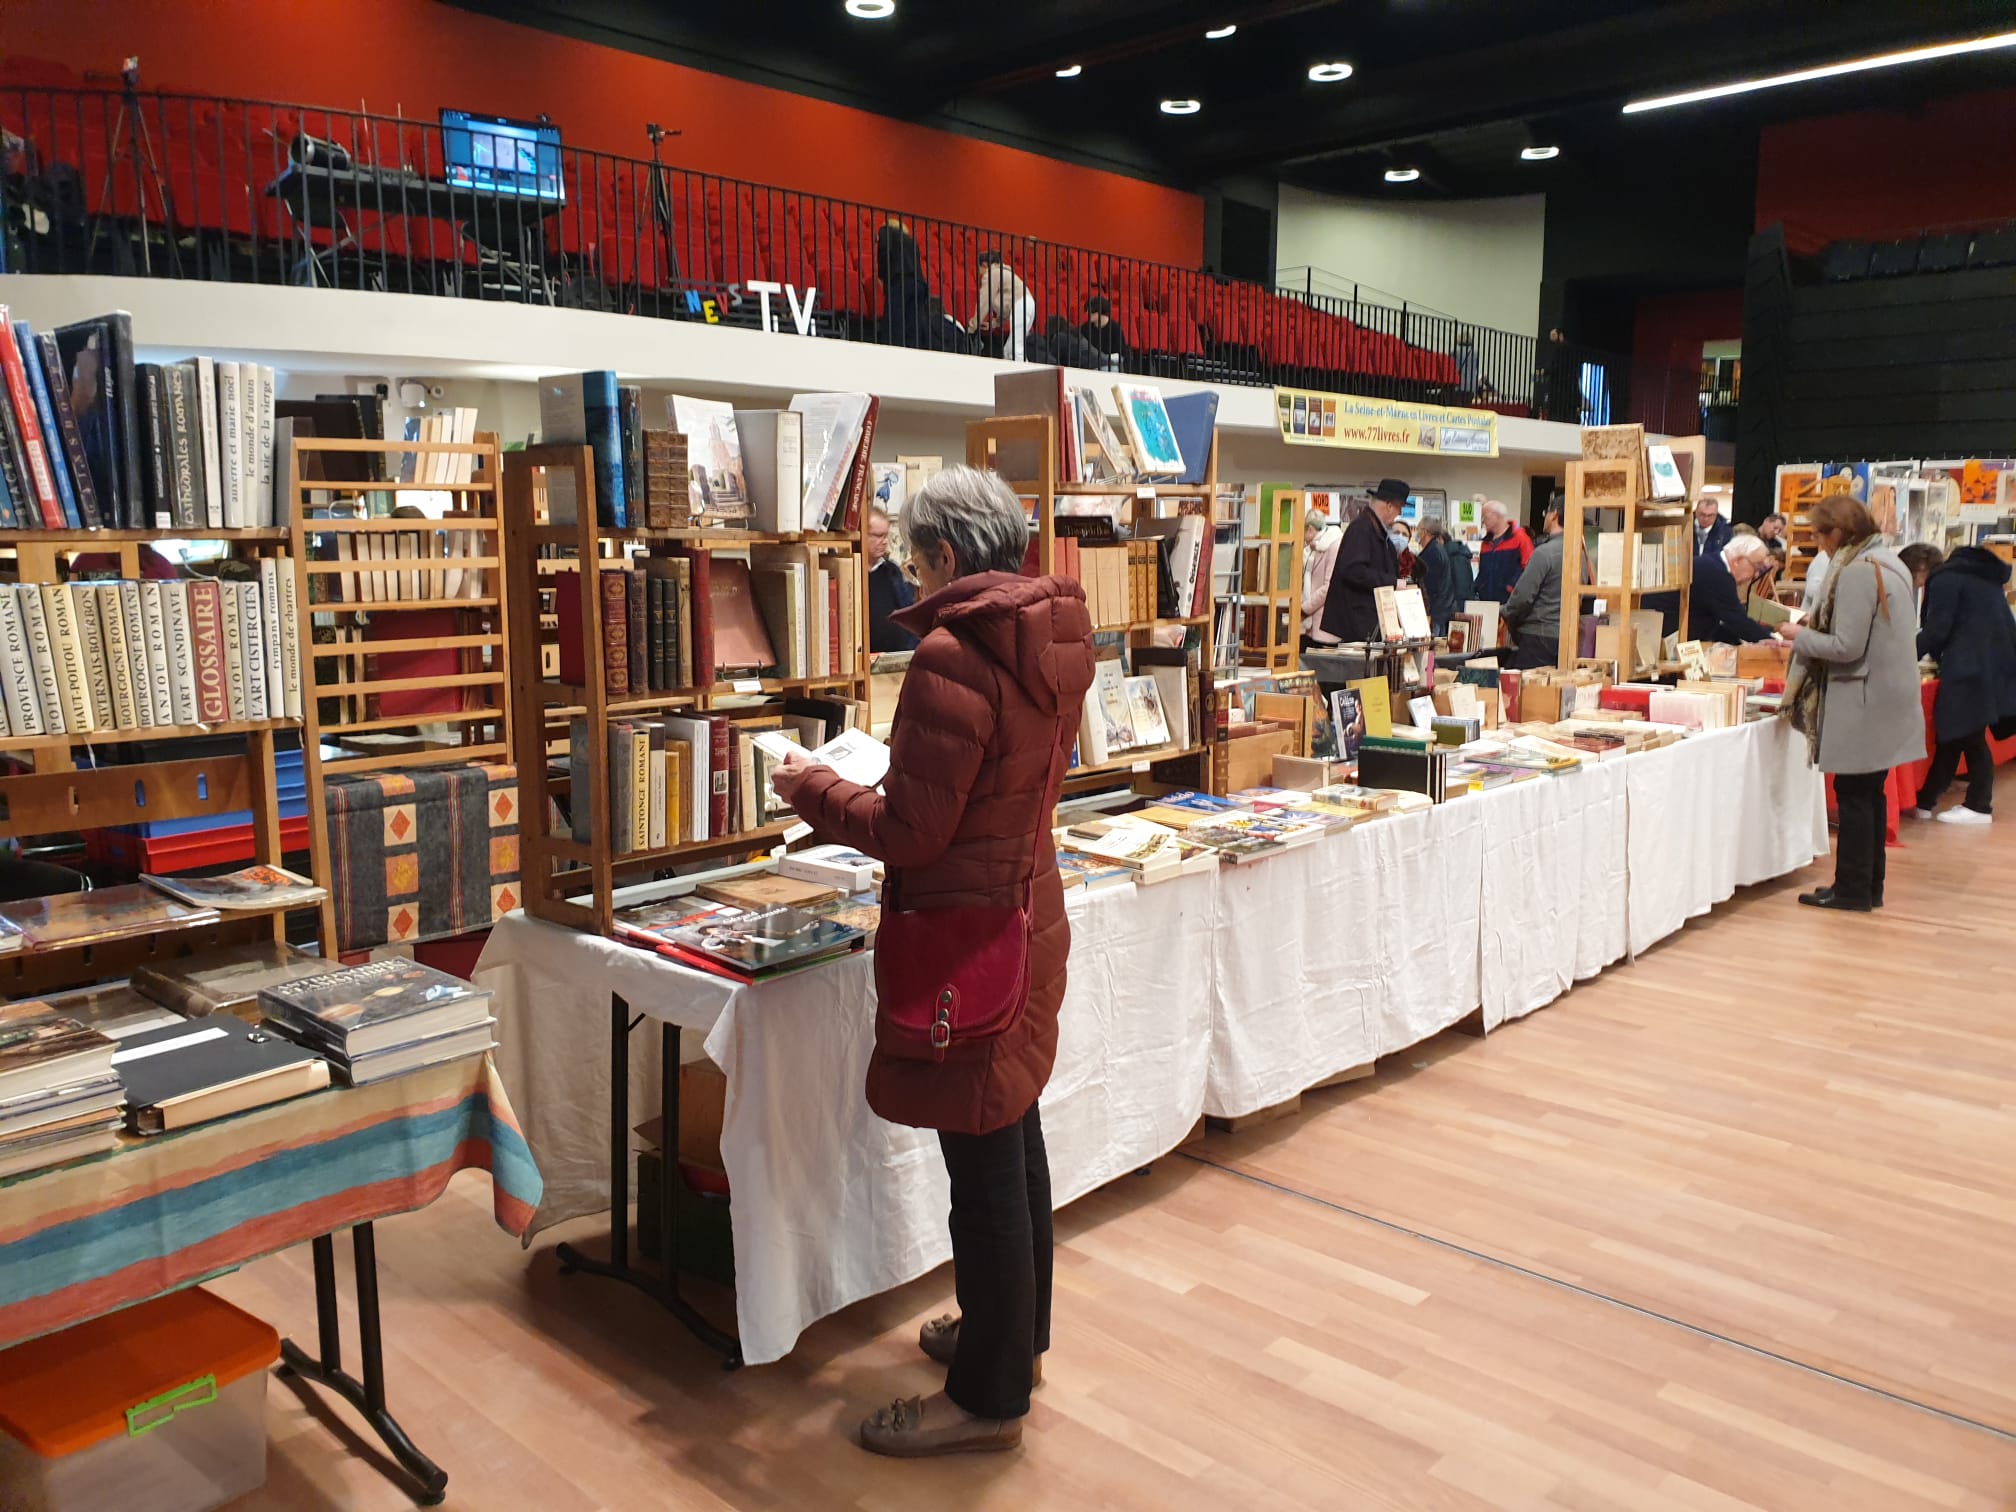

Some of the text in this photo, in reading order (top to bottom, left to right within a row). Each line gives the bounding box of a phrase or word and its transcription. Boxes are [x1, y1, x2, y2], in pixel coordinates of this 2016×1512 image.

[224, 376, 238, 503] auxerre et marie noël
[245, 379, 254, 477] le monde d'autun
[260, 380, 272, 484] la vie de la vierge
[1344, 401, 1354, 414] La
[1344, 426, 1410, 443] www.77livres.fr
[1313, 493, 1328, 506] NORD
[1463, 502, 1473, 515] SUD
[1, 591, 37, 730] PROVENCE ROMANE
[27, 590, 62, 731] POITOU ROMAN
[53, 588, 87, 730] HAUT-POITOU ROMAN
[109, 590, 133, 725] BOURGOGNE ROMANE
[126, 587, 151, 726] BOURGOGNE ROMANE
[146, 587, 170, 721] ANJOU ROMAN
[170, 591, 192, 721] L'ART SCANDINAVE
[194, 588, 222, 717] GLOSSAIRE
[225, 587, 244, 717] ANJOU ROMAN
[244, 585, 263, 716] L'ART CISTERCIEN
[267, 572, 281, 670] tympans romans
[284, 578, 298, 692] le monde de chartres
[638, 740, 646, 846] SAINTONGE ROMANE
